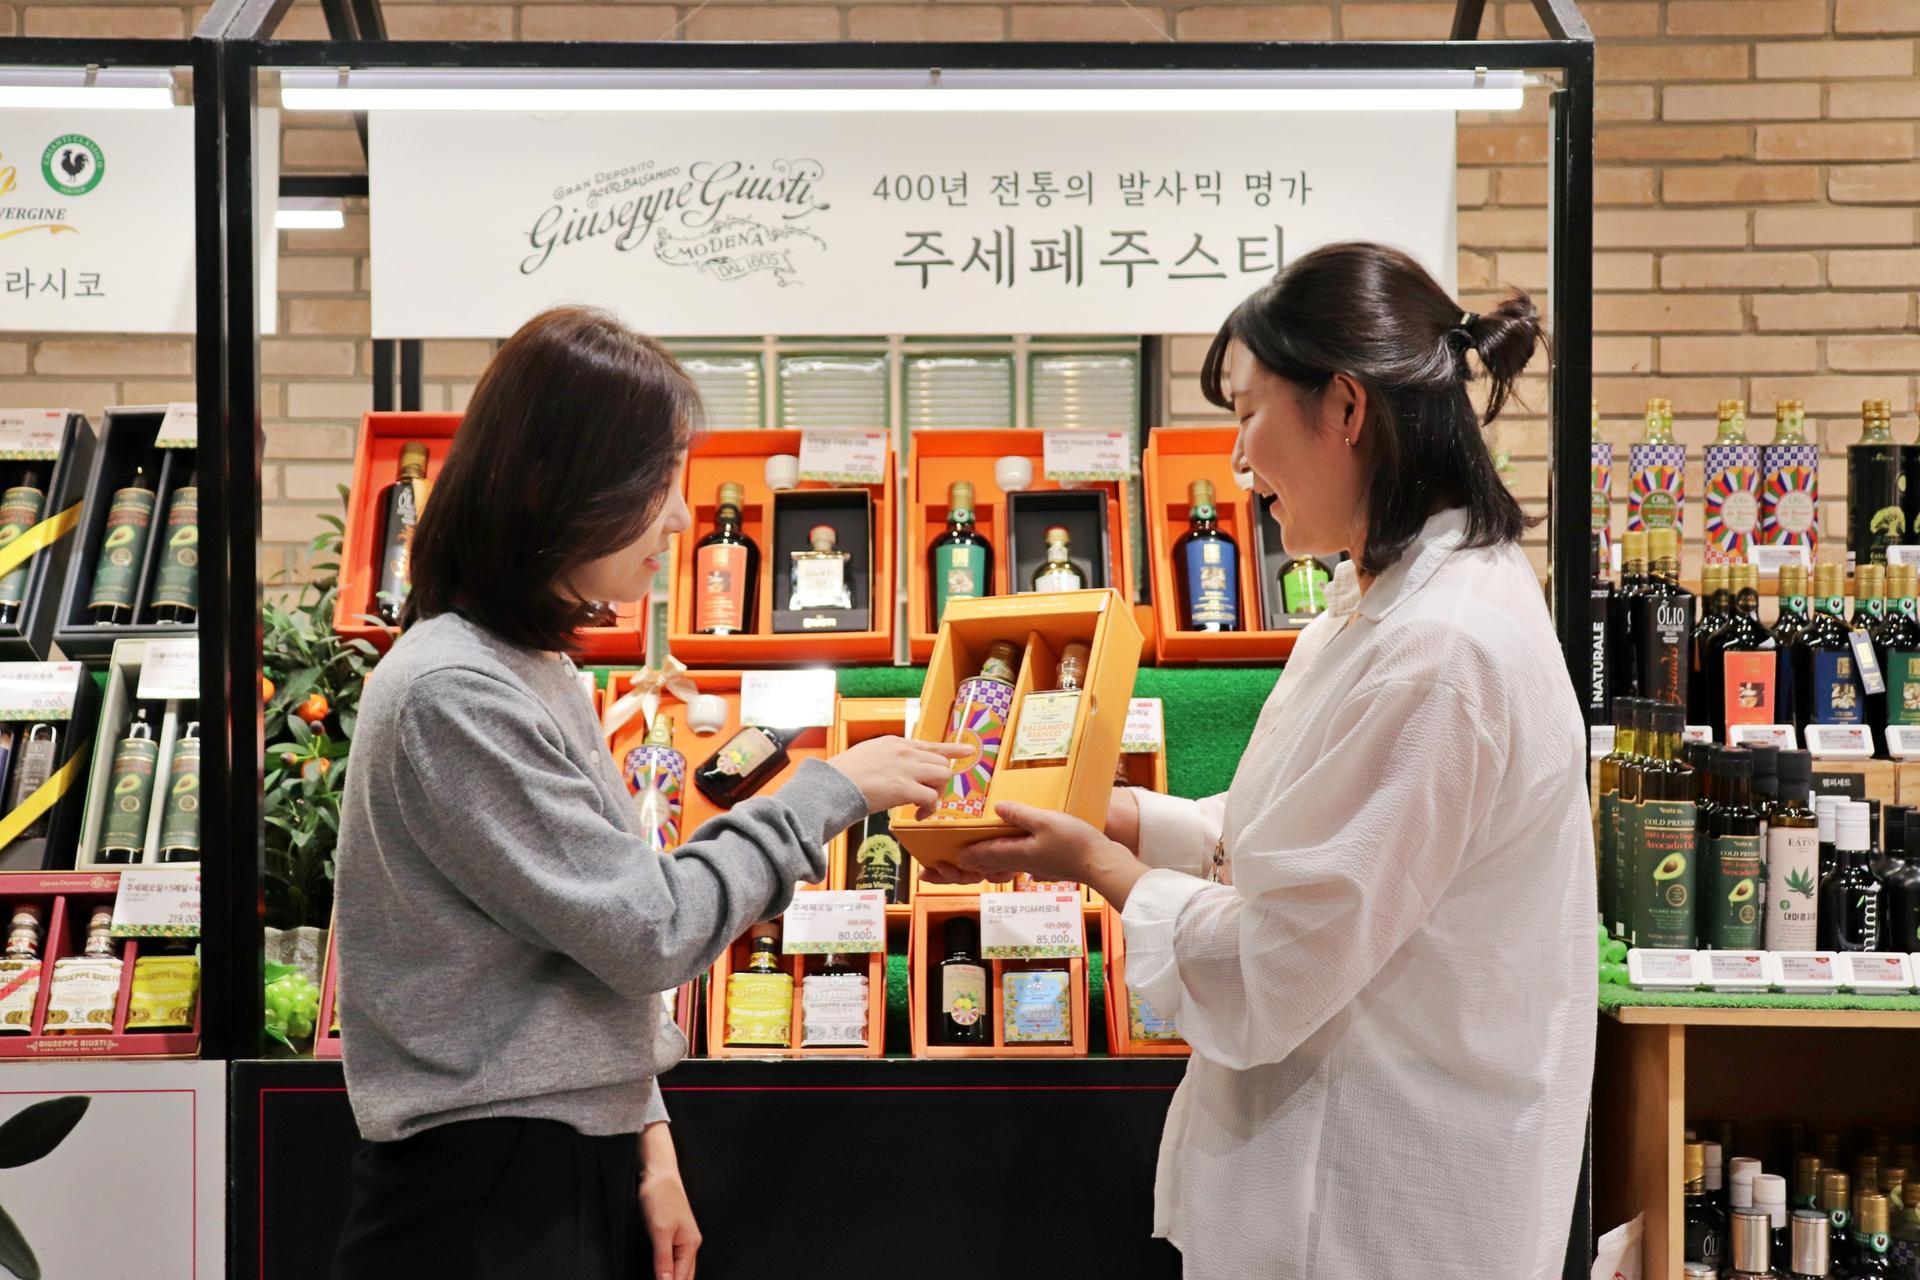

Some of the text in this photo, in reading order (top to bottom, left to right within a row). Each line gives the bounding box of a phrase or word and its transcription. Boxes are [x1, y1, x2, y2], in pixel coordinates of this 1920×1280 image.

[553, 159, 655, 200] GRAN DEPOSITO
[623, 166, 680, 190] BALSAMICO
[873, 171, 1314, 208] 400년 전통의 발사믹 명가
[520, 158, 831, 275] Giuseppe Giusti
[677, 231, 765, 259] MODENA
[717, 252, 780, 278] DAL 1605
[5, 267, 106, 300] 라시코
[1656, 604, 1685, 625] OLIO
[1593, 621, 1604, 702] NATURALE
[1646, 841, 1683, 850] Avocado
[38, 1040, 79, 1048] GIUSEPPE
